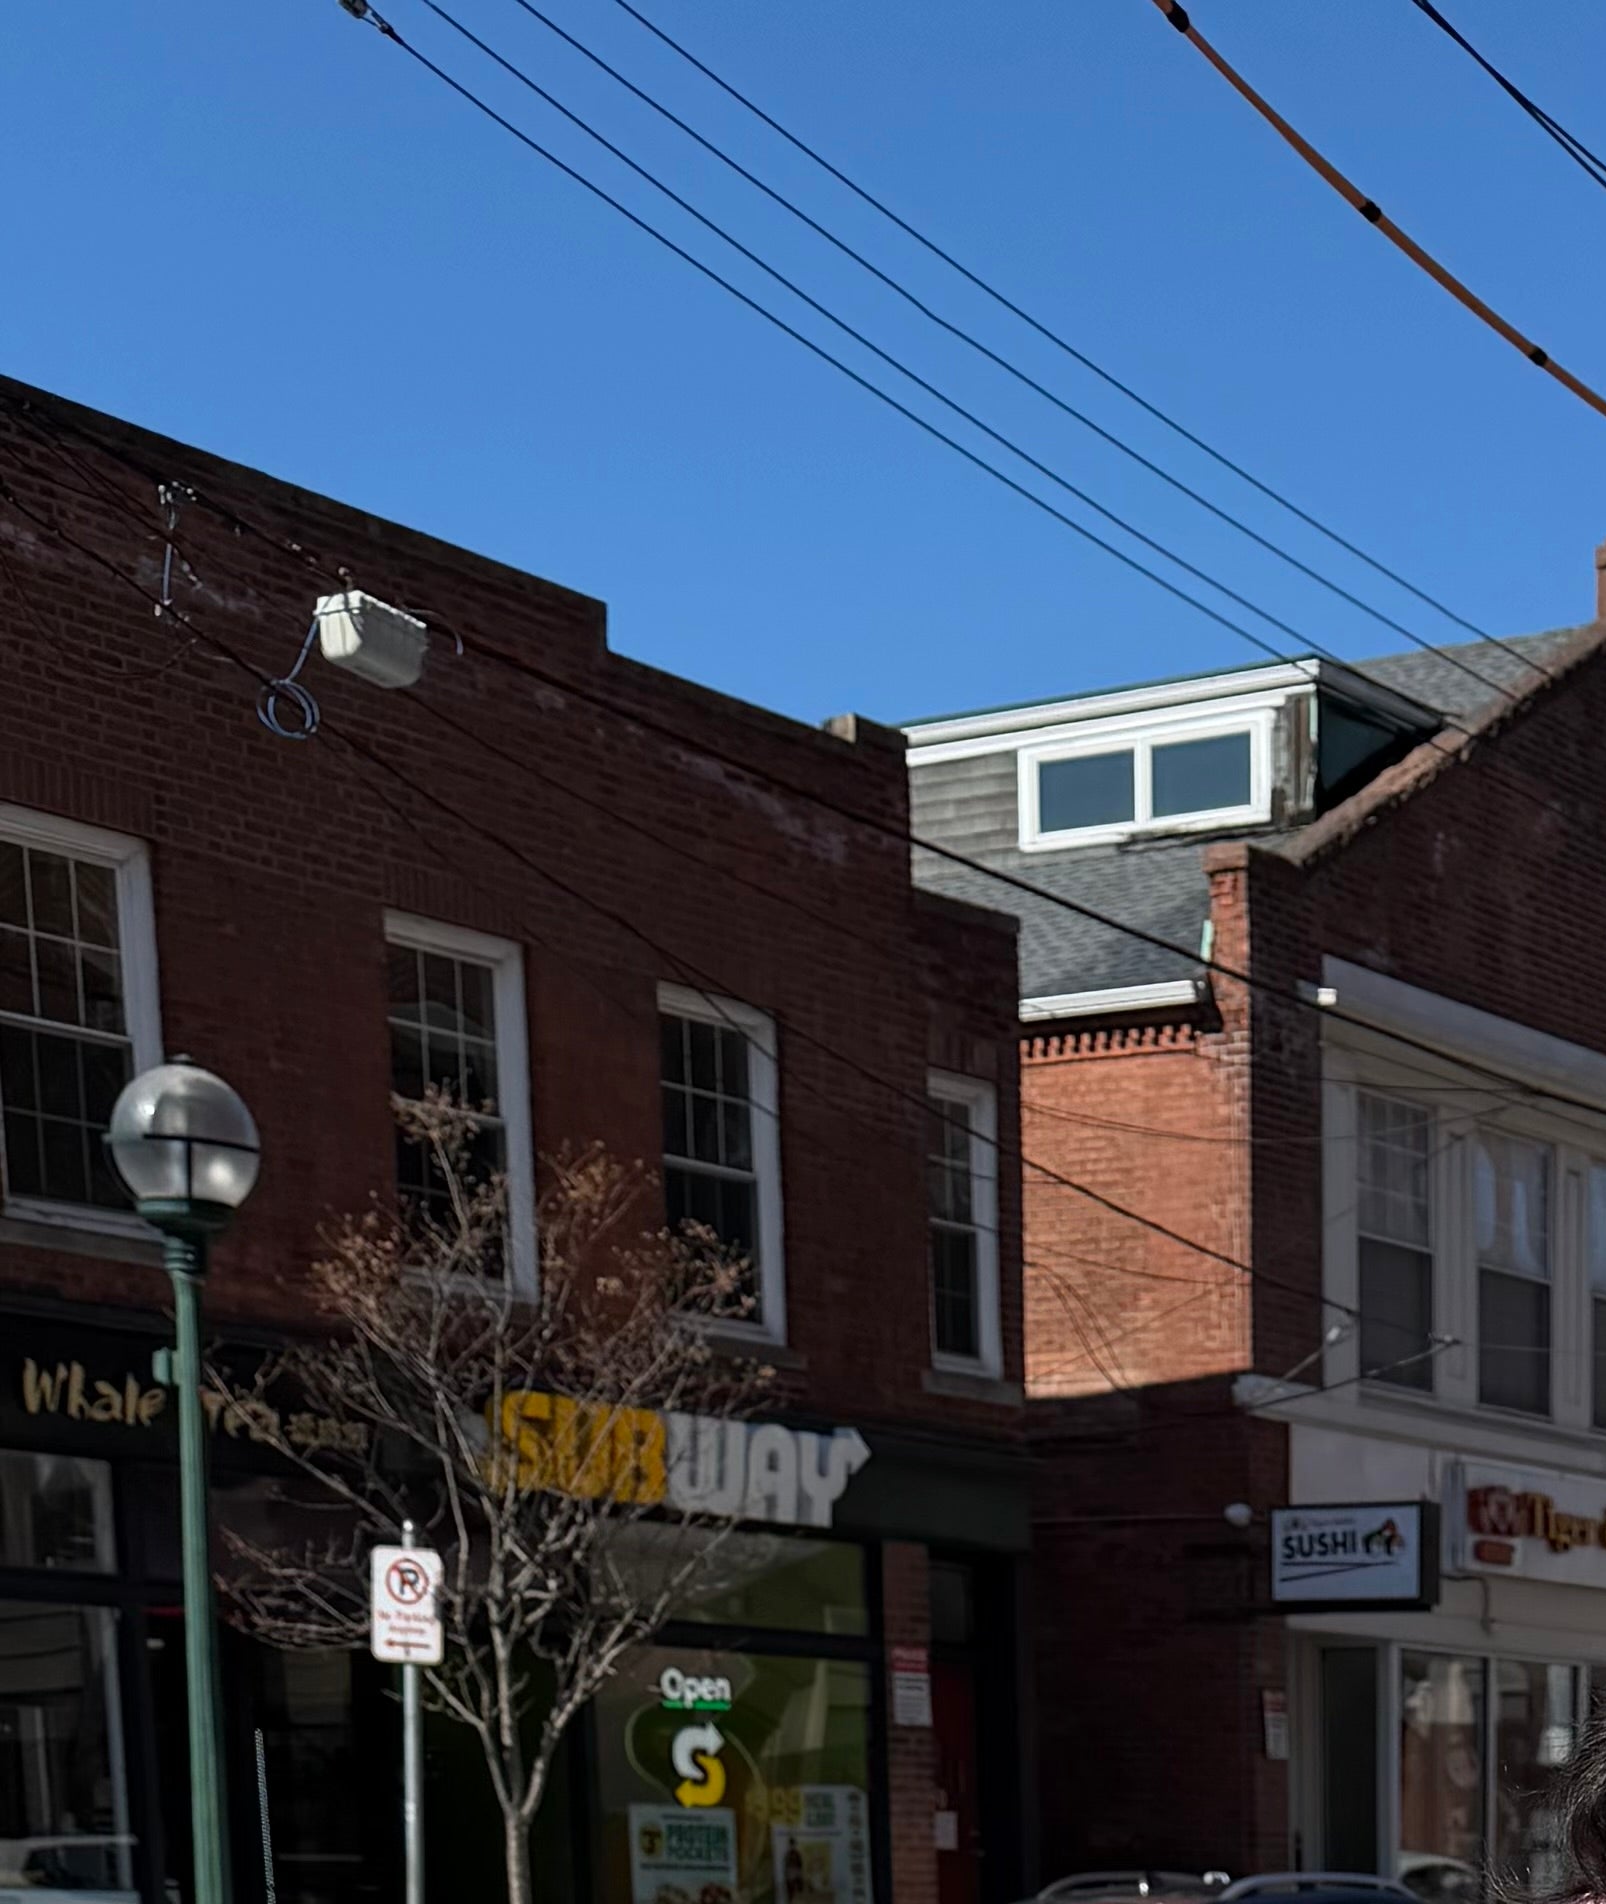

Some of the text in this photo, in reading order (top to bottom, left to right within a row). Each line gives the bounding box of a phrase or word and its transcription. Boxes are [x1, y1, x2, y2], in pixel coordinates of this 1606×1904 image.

[22, 1357, 167, 1427] Whale
[484, 1389, 873, 1530] SUBWAY
[1282, 1529, 1357, 1560] SUSHI
[660, 1666, 731, 1709] Open
